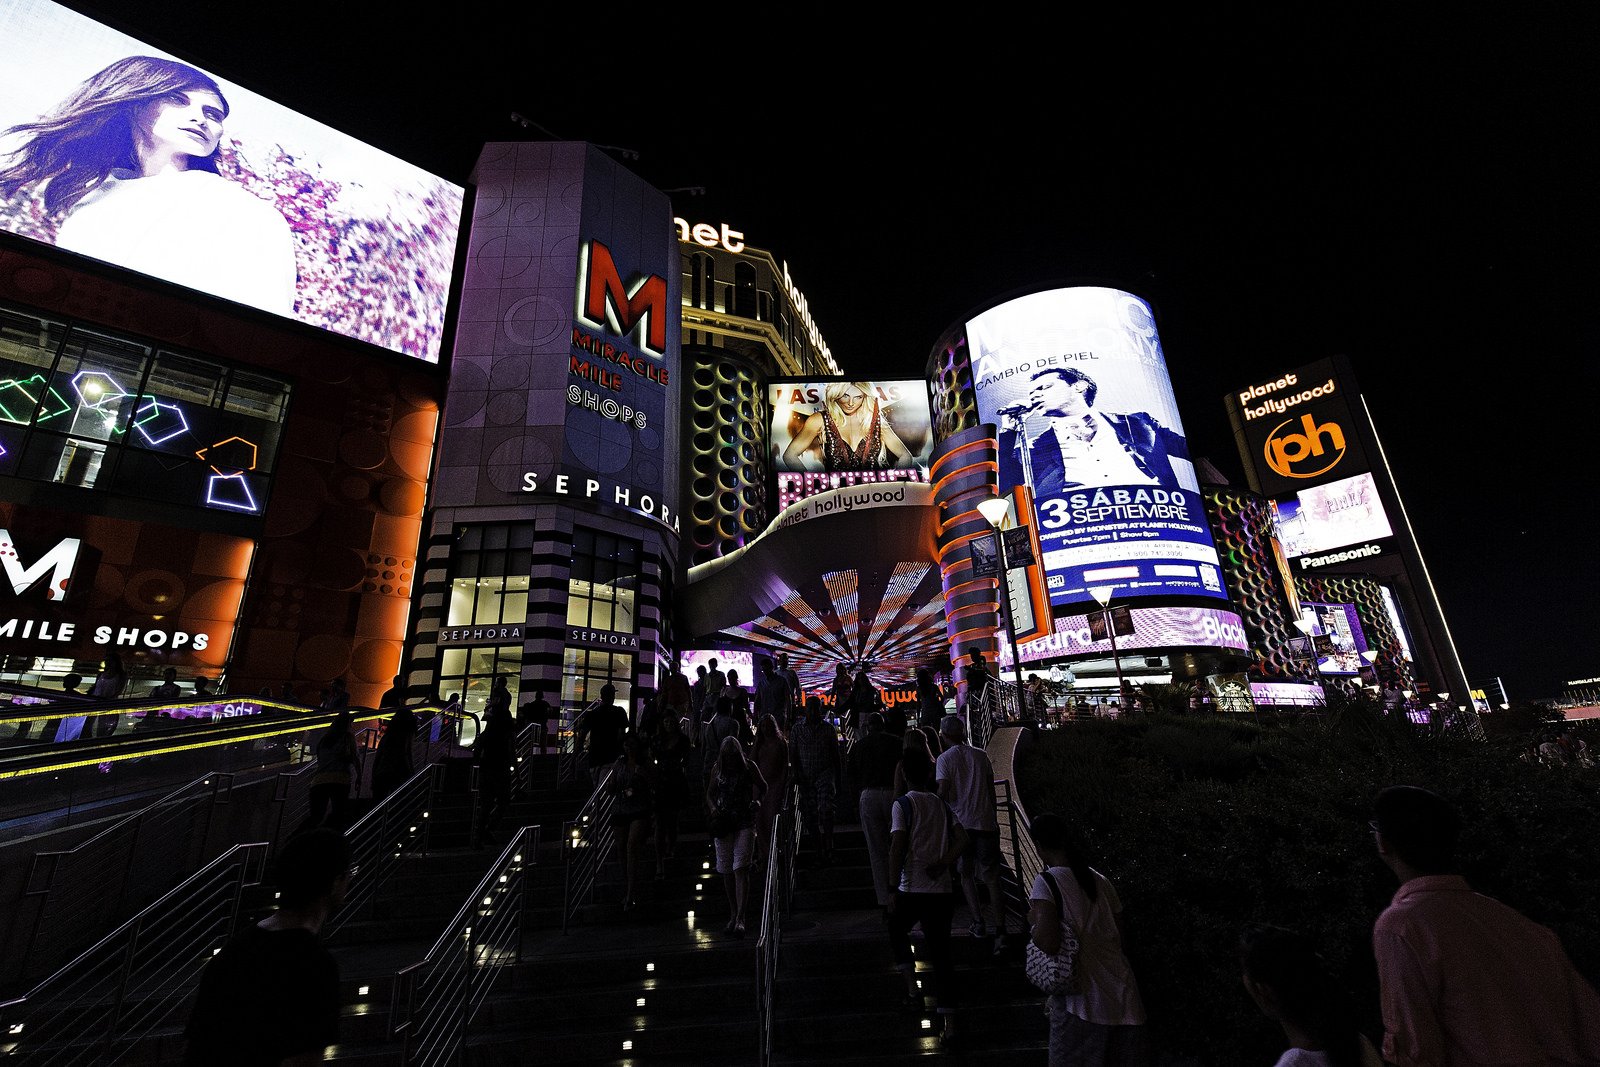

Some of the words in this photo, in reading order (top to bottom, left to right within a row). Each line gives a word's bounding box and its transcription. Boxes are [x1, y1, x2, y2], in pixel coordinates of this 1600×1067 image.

[674, 217, 745, 253] net
[580, 238, 668, 356] M
[571, 327, 669, 385] MIRACLE
[975, 362, 1031, 392] CAMBIO
[1036, 355, 1058, 368] DE
[1064, 351, 1099, 363] PIEL
[569, 354, 623, 393] MILE
[1239, 373, 1298, 406] planet
[567, 384, 647, 429] SHOPS
[1244, 378, 1336, 421] hollywood
[1270, 413, 1346, 477] ph
[522, 472, 681, 533] SEPHORA
[815, 487, 905, 515] hollywood
[1070, 488, 1186, 510] SÁBADO
[1072, 504, 1191, 524] SEPTIEMBRE
[1039, 529, 1074, 541] OWERED
[1074, 527, 1086, 535] BY
[1087, 523, 1129, 533] MONSTER
[1168, 522, 1204, 534] HOLLYWOOD
[1093, 534, 1111, 542] 7pm
[1300, 544, 1382, 570] Panasonic
[0, 618, 76, 642] MILE
[94, 626, 209, 651] SHOPS
[441, 627, 520, 641] SEPHORA
[572, 630, 637, 647] SEPHORA
